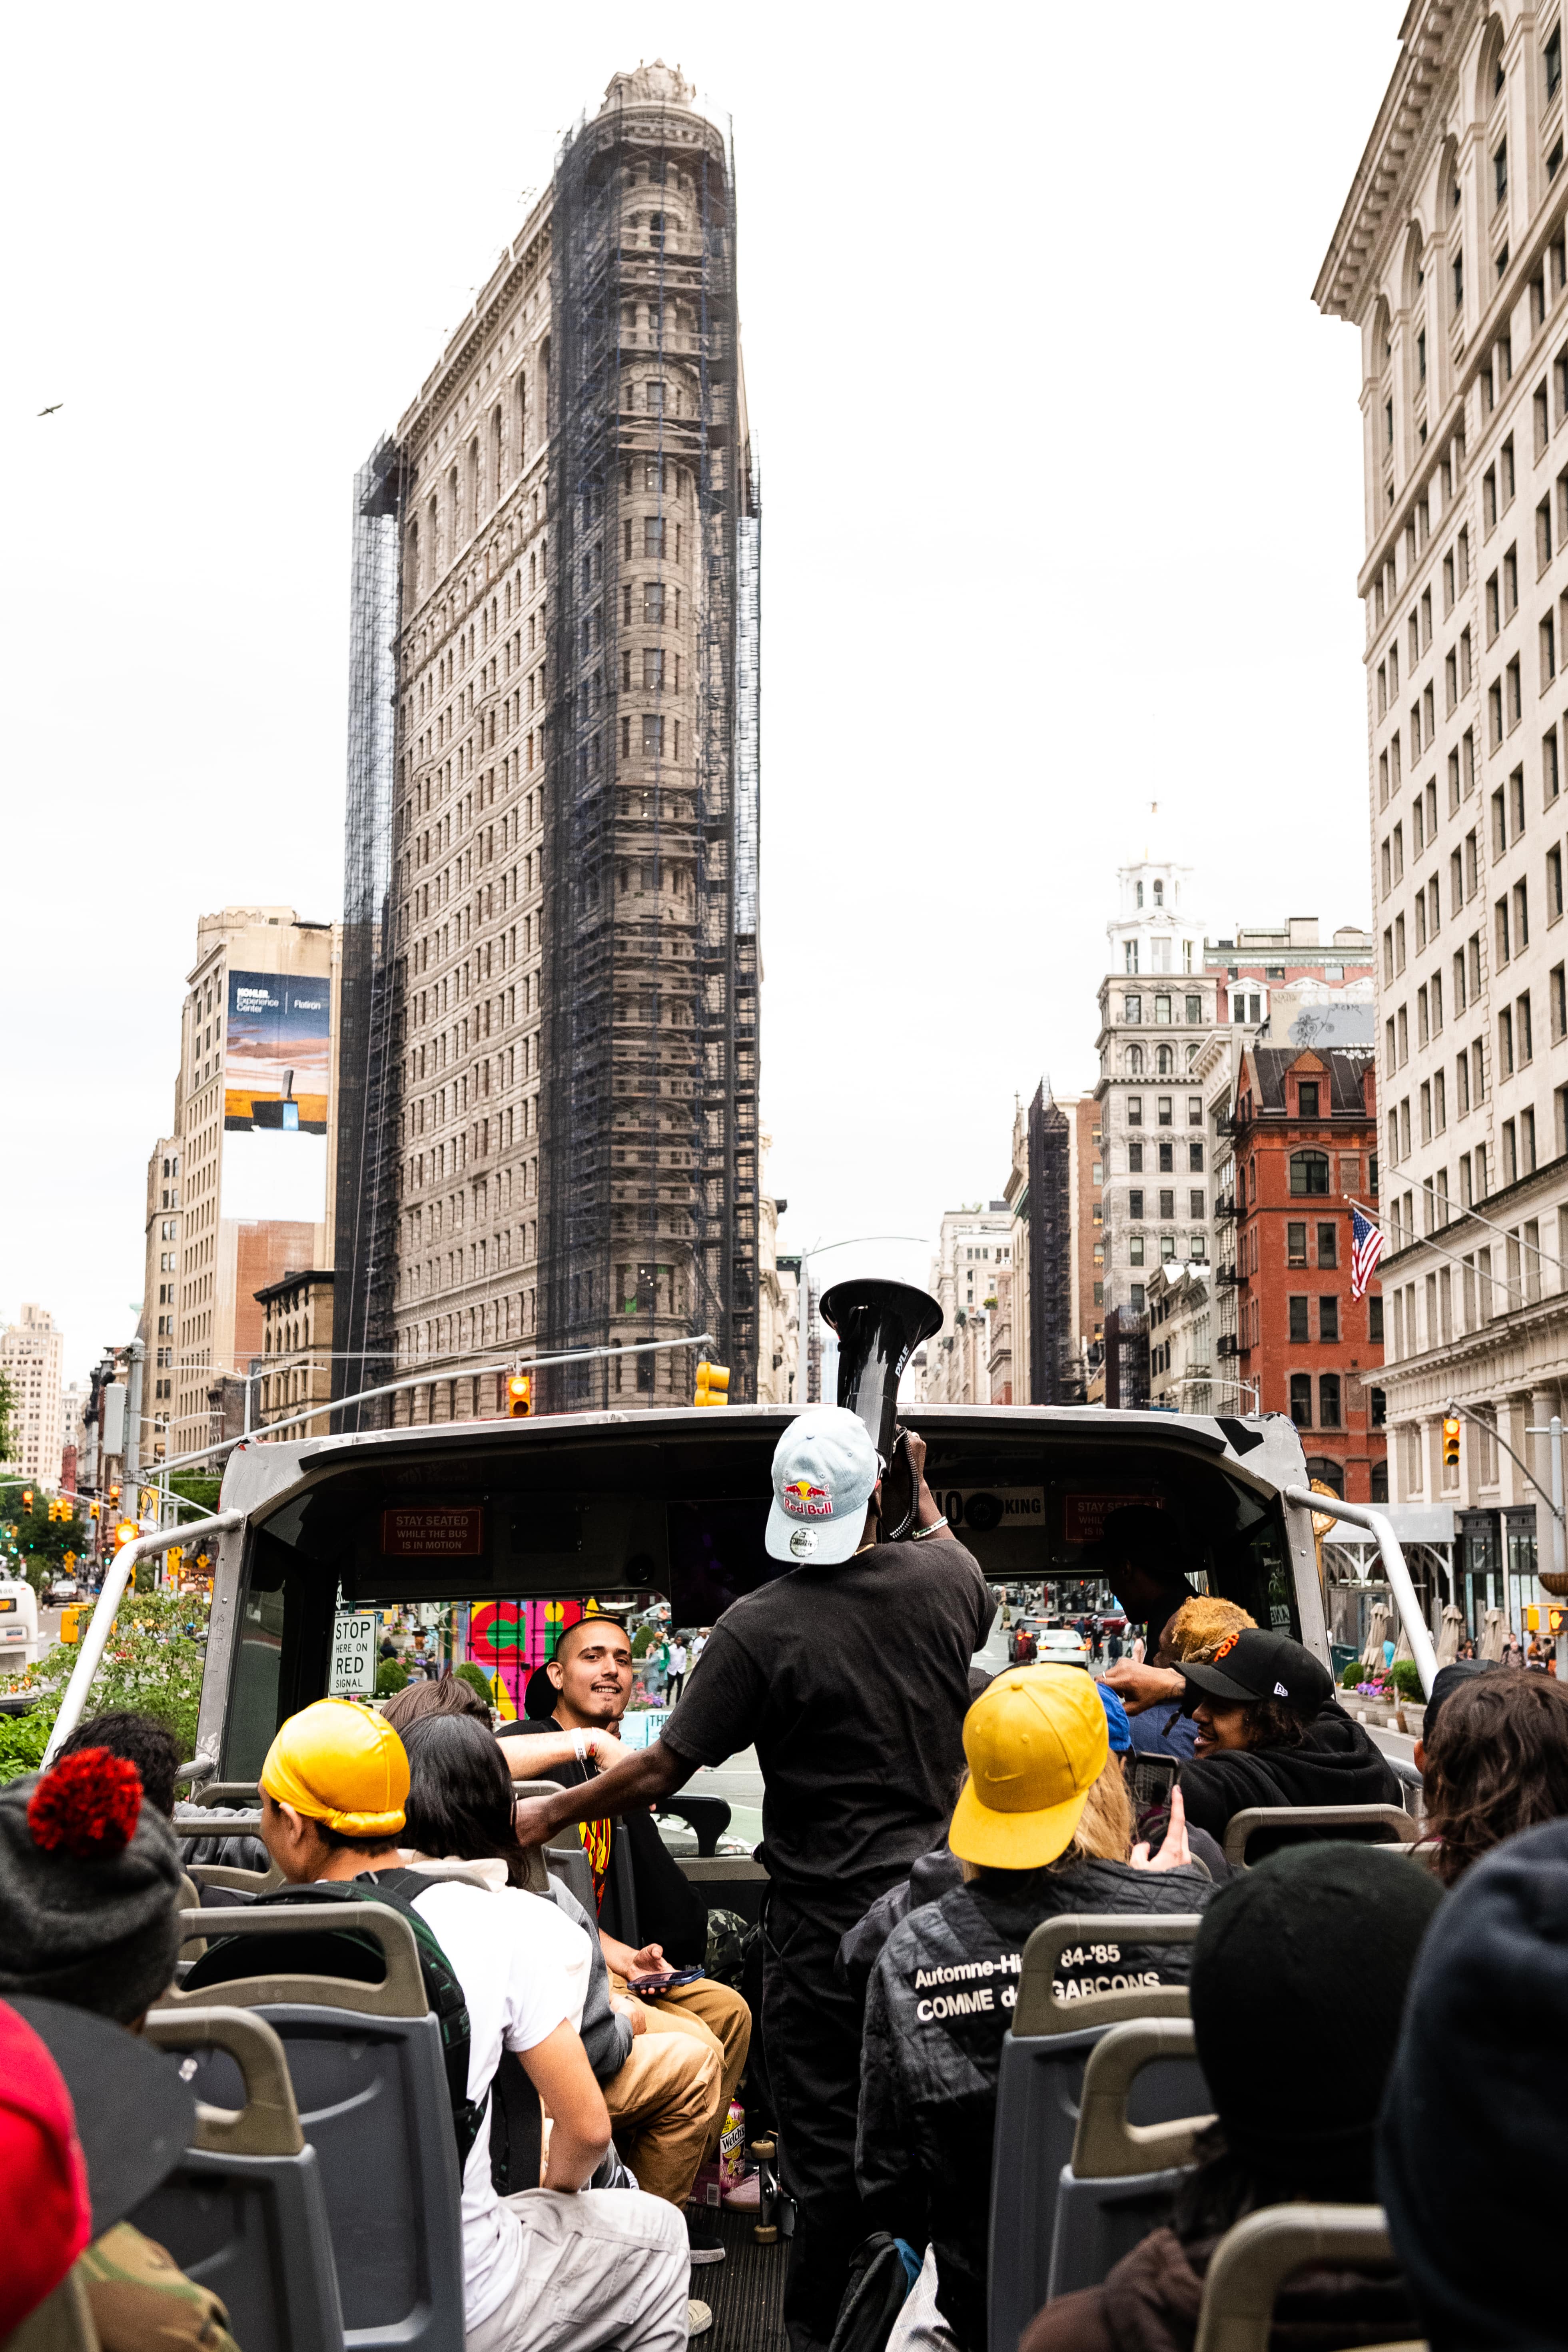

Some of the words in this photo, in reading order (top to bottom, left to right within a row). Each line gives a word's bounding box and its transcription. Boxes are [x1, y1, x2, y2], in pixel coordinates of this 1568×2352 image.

[237, 996, 279, 1007] Experience
[294, 999, 321, 1010] Flatiron
[236, 1003, 263, 1013] Center
[895, 1344, 909, 1378] PYLE
[784, 1497, 804, 1514] Red
[807, 1502, 832, 1515] Bull
[1078, 1502, 1105, 1512] STAY
[396, 1516, 423, 1526] STAY
[425, 1516, 469, 1526] SEATED
[397, 1530, 426, 1538] WHILE
[429, 1530, 446, 1538] THE
[449, 1530, 467, 1538] BUS
[1085, 1527, 1094, 1536] IS
[336, 1622, 370, 1640] STOP
[336, 1644, 351, 1653] HERE
[356, 1643, 367, 1652] ON
[336, 1657, 363, 1674] RED
[336, 1678, 363, 1688] SIGNAL
[917, 1988, 995, 2021] COMME
[722, 2126, 744, 2150] Welch's
